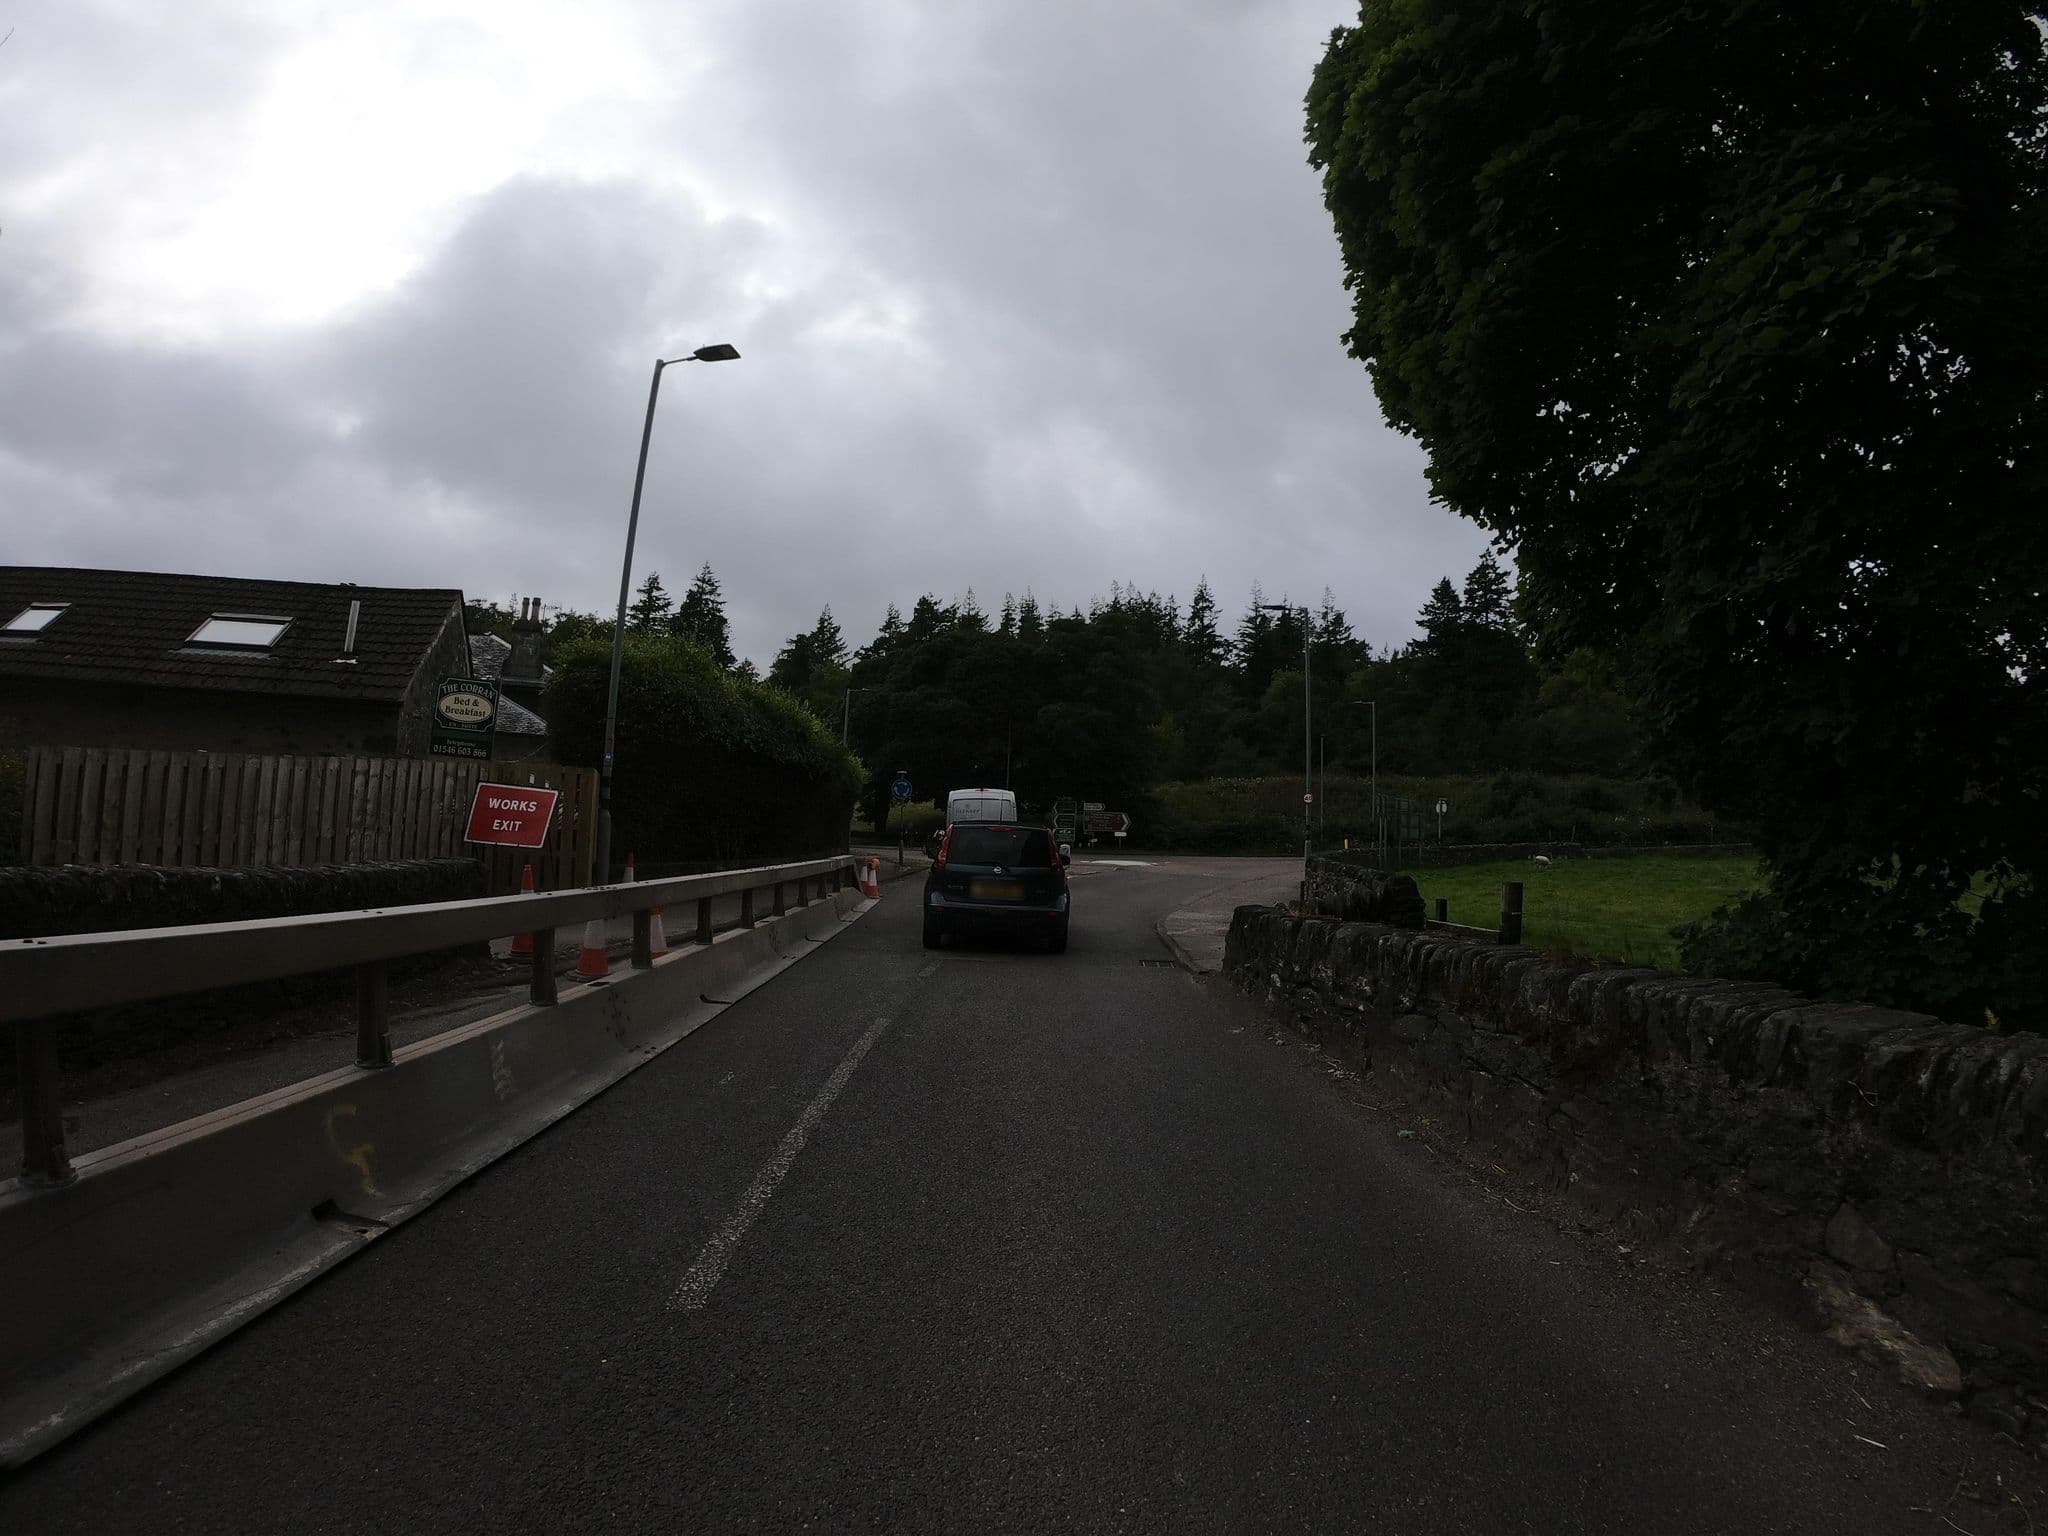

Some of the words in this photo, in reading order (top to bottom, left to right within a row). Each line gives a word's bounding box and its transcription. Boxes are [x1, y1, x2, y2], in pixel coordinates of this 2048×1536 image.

[442, 684, 458, 694] THE
[454, 696, 470, 706] Bed
[472, 699, 480, 707] &
[445, 706, 486, 718] Breakfast
[488, 797, 538, 812] WORKS
[492, 818, 523, 832] EXIT
